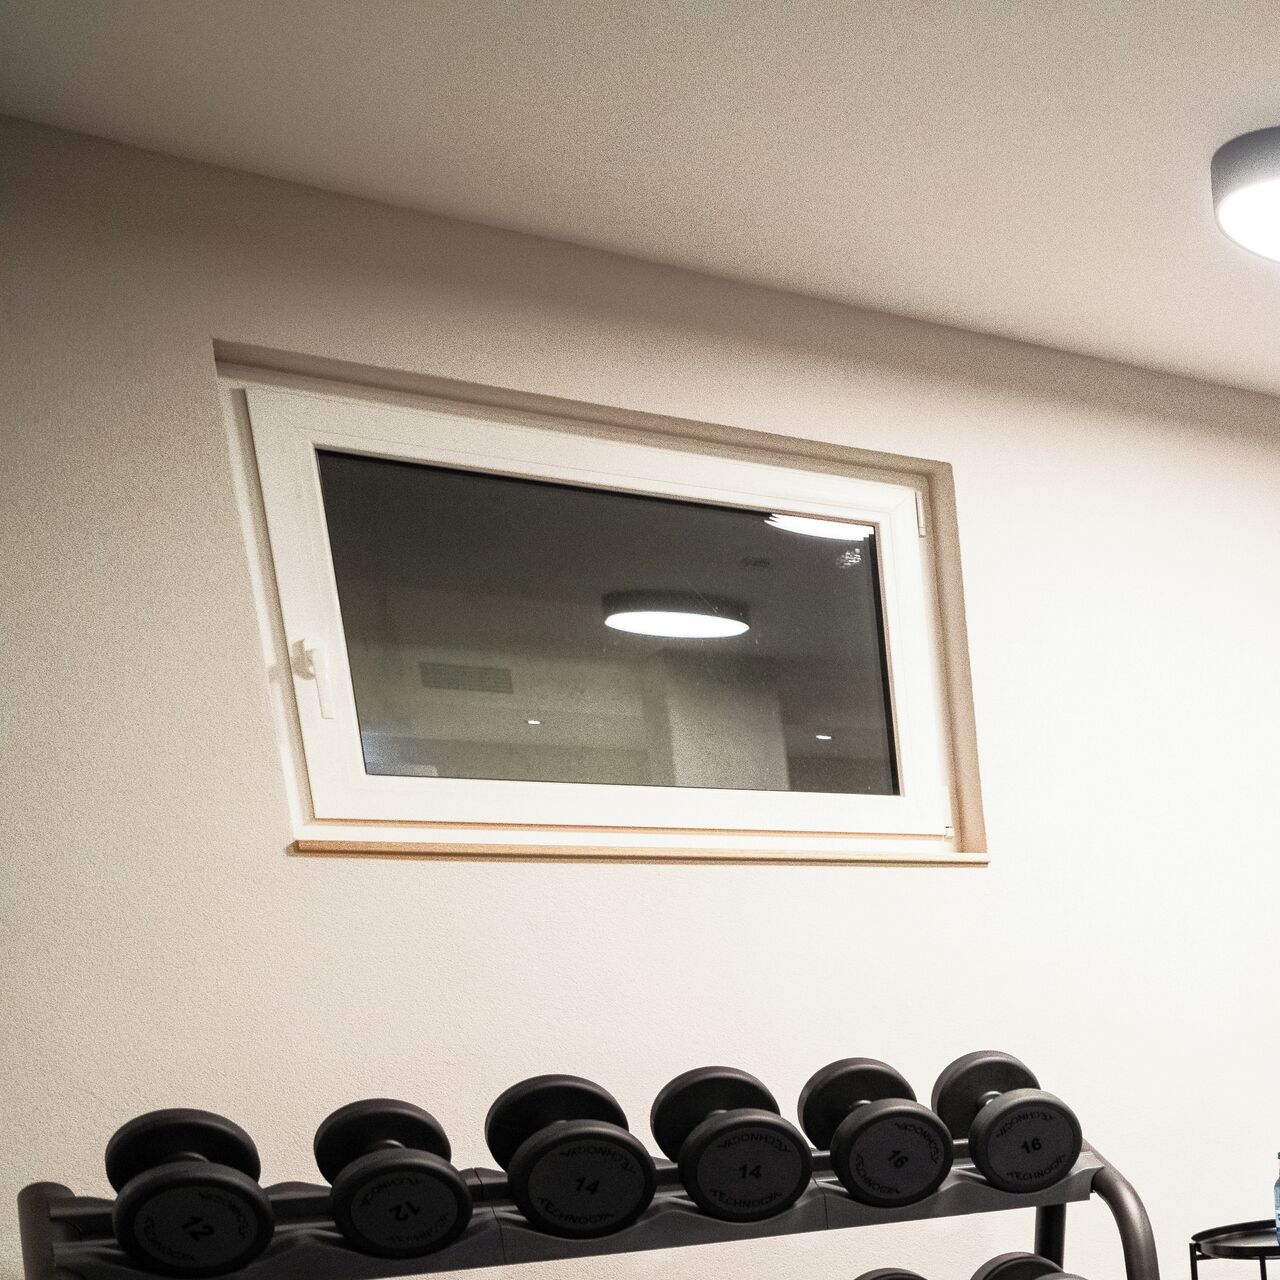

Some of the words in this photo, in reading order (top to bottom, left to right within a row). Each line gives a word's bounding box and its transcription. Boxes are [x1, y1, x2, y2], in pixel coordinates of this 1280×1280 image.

[1021, 1138, 1042, 1154] 16
[887, 1149, 909, 1169] 16
[738, 1164, 762, 1179] 14
[575, 1177, 600, 1195] 14
[389, 1201, 421, 1221] 12
[182, 1215, 214, 1241] 12
